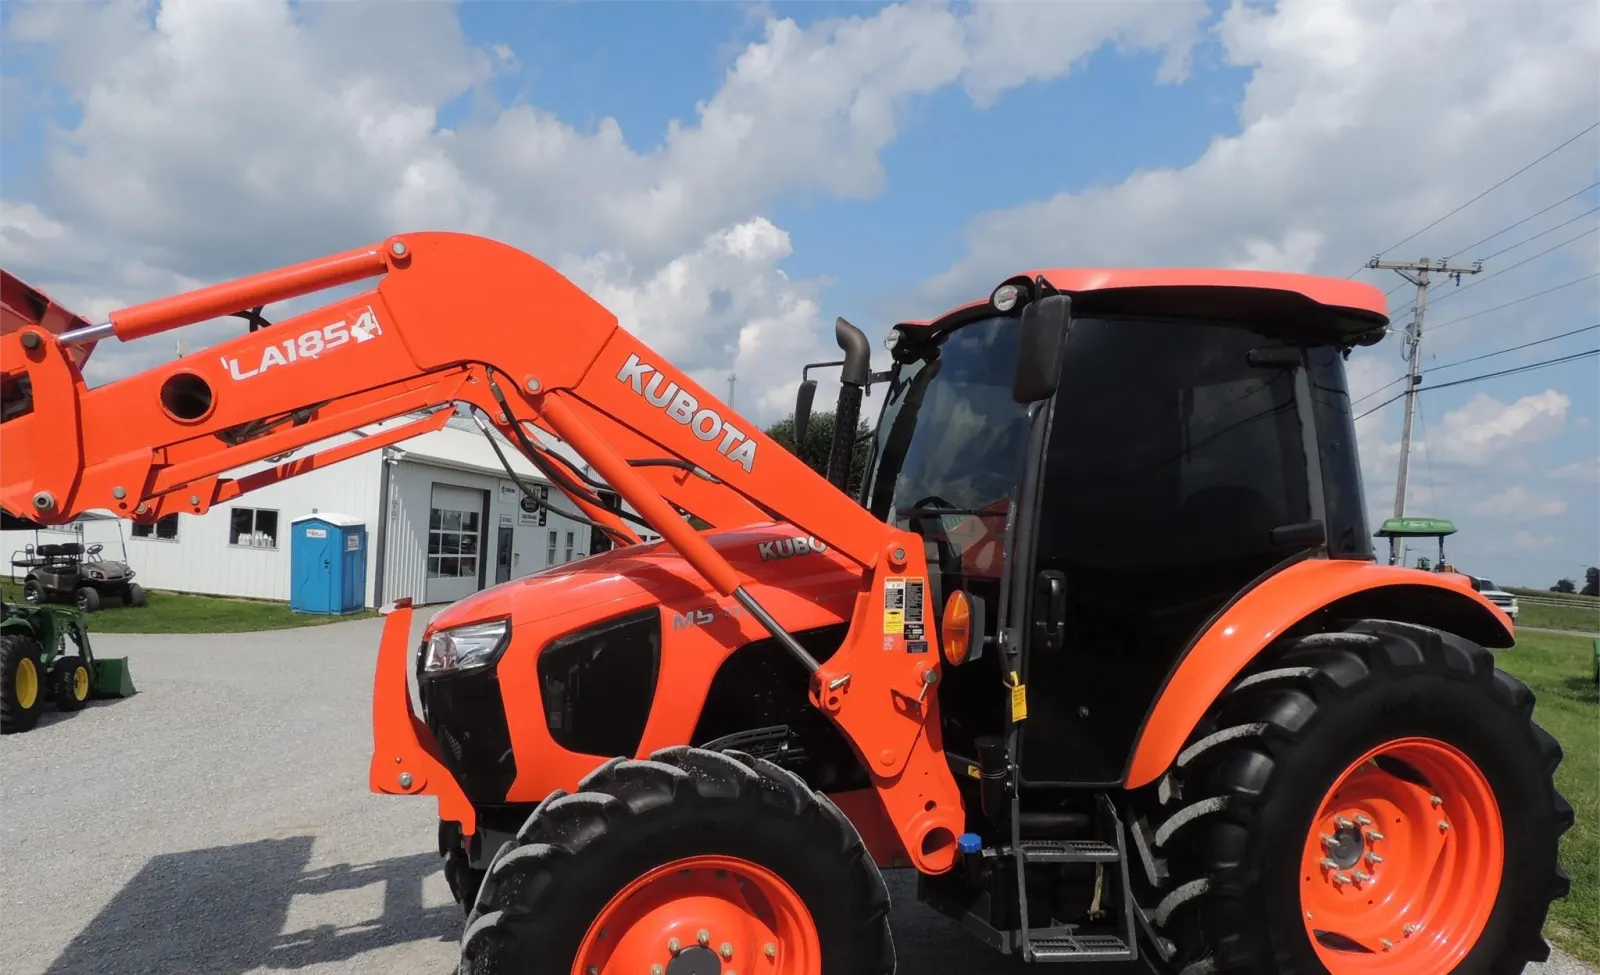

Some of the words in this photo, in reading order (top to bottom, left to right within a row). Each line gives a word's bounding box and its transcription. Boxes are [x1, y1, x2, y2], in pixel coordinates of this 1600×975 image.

[229, 310, 377, 381] LA1854
[616, 352, 758, 475] KUBOTA
[757, 535, 827, 562] KUBO
